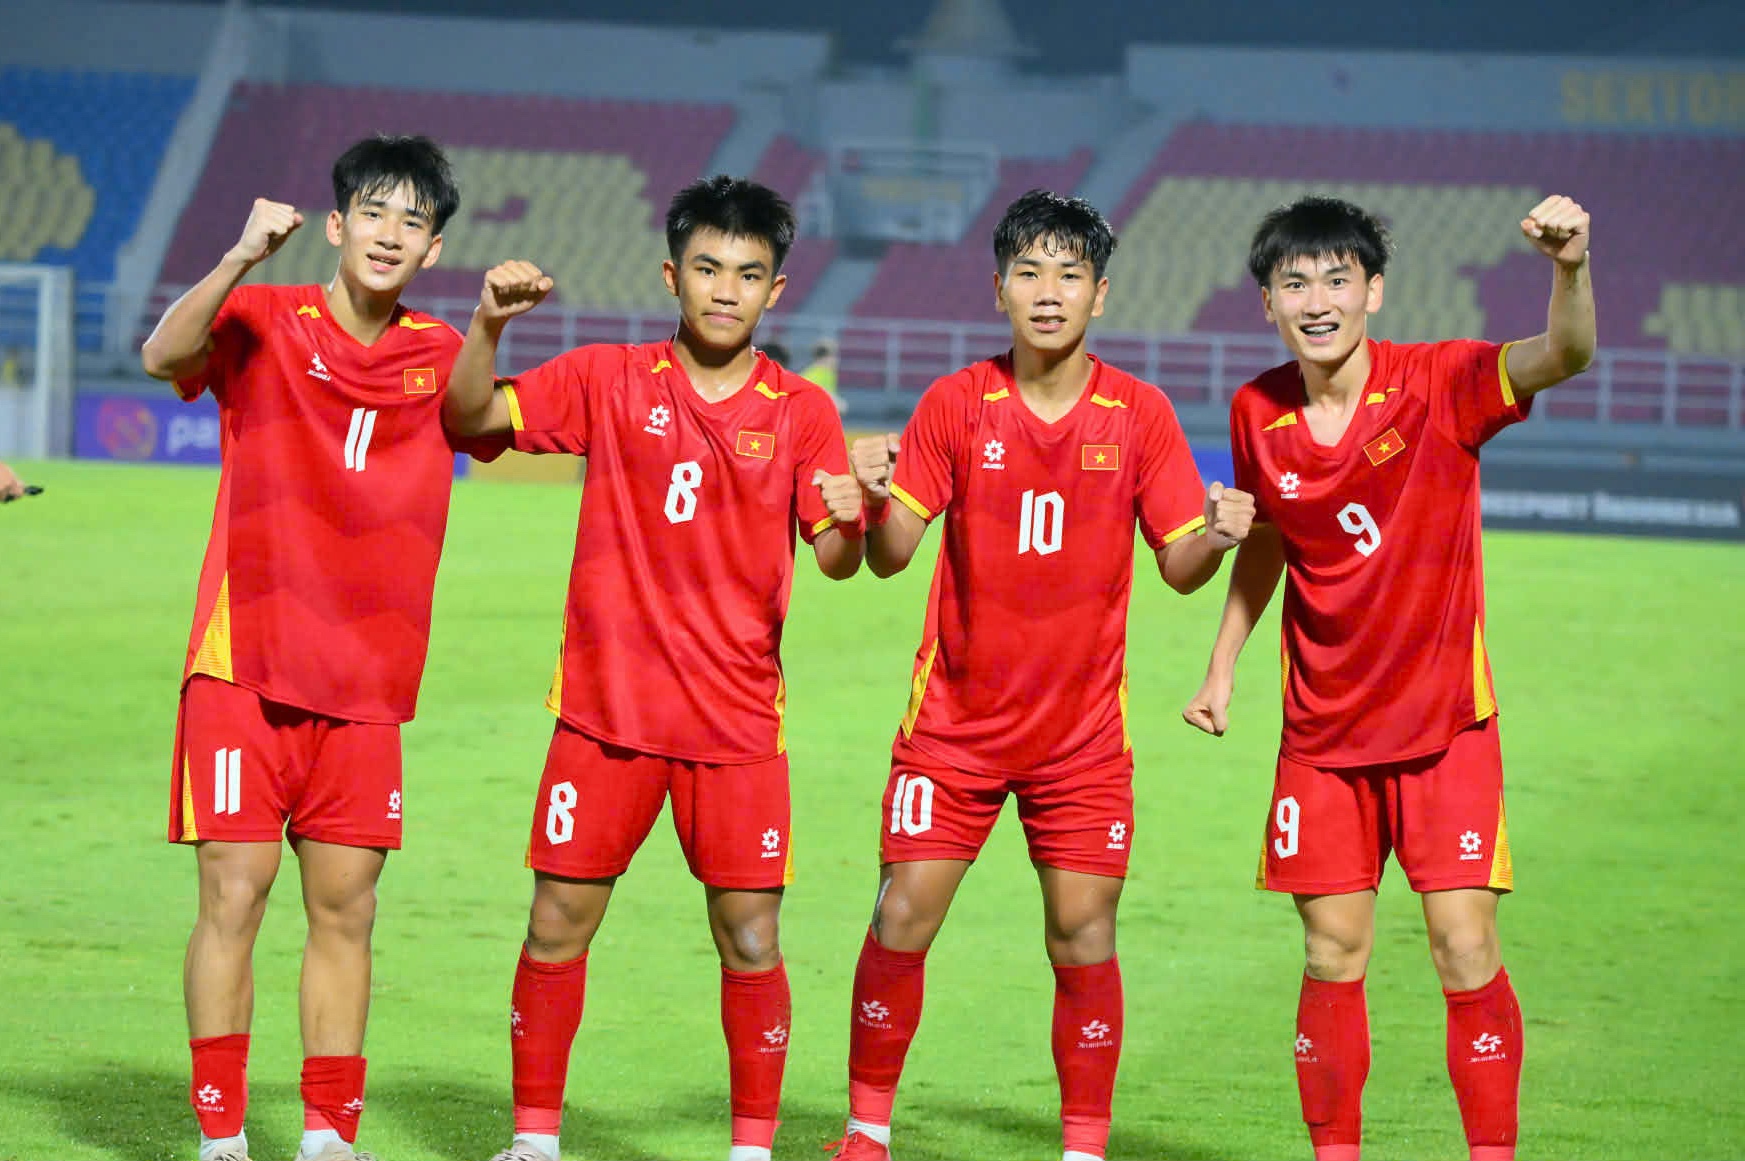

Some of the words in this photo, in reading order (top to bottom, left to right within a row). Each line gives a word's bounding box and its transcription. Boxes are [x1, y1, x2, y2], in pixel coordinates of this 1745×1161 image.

[344, 408, 378, 473] 11
[664, 461, 703, 524] 8
[1019, 490, 1065, 556] 10
[1337, 502, 1382, 557] 9
[214, 748, 242, 815] 11
[546, 781, 578, 845] 8
[890, 773, 935, 836] 10
[1274, 795, 1300, 859] 9
